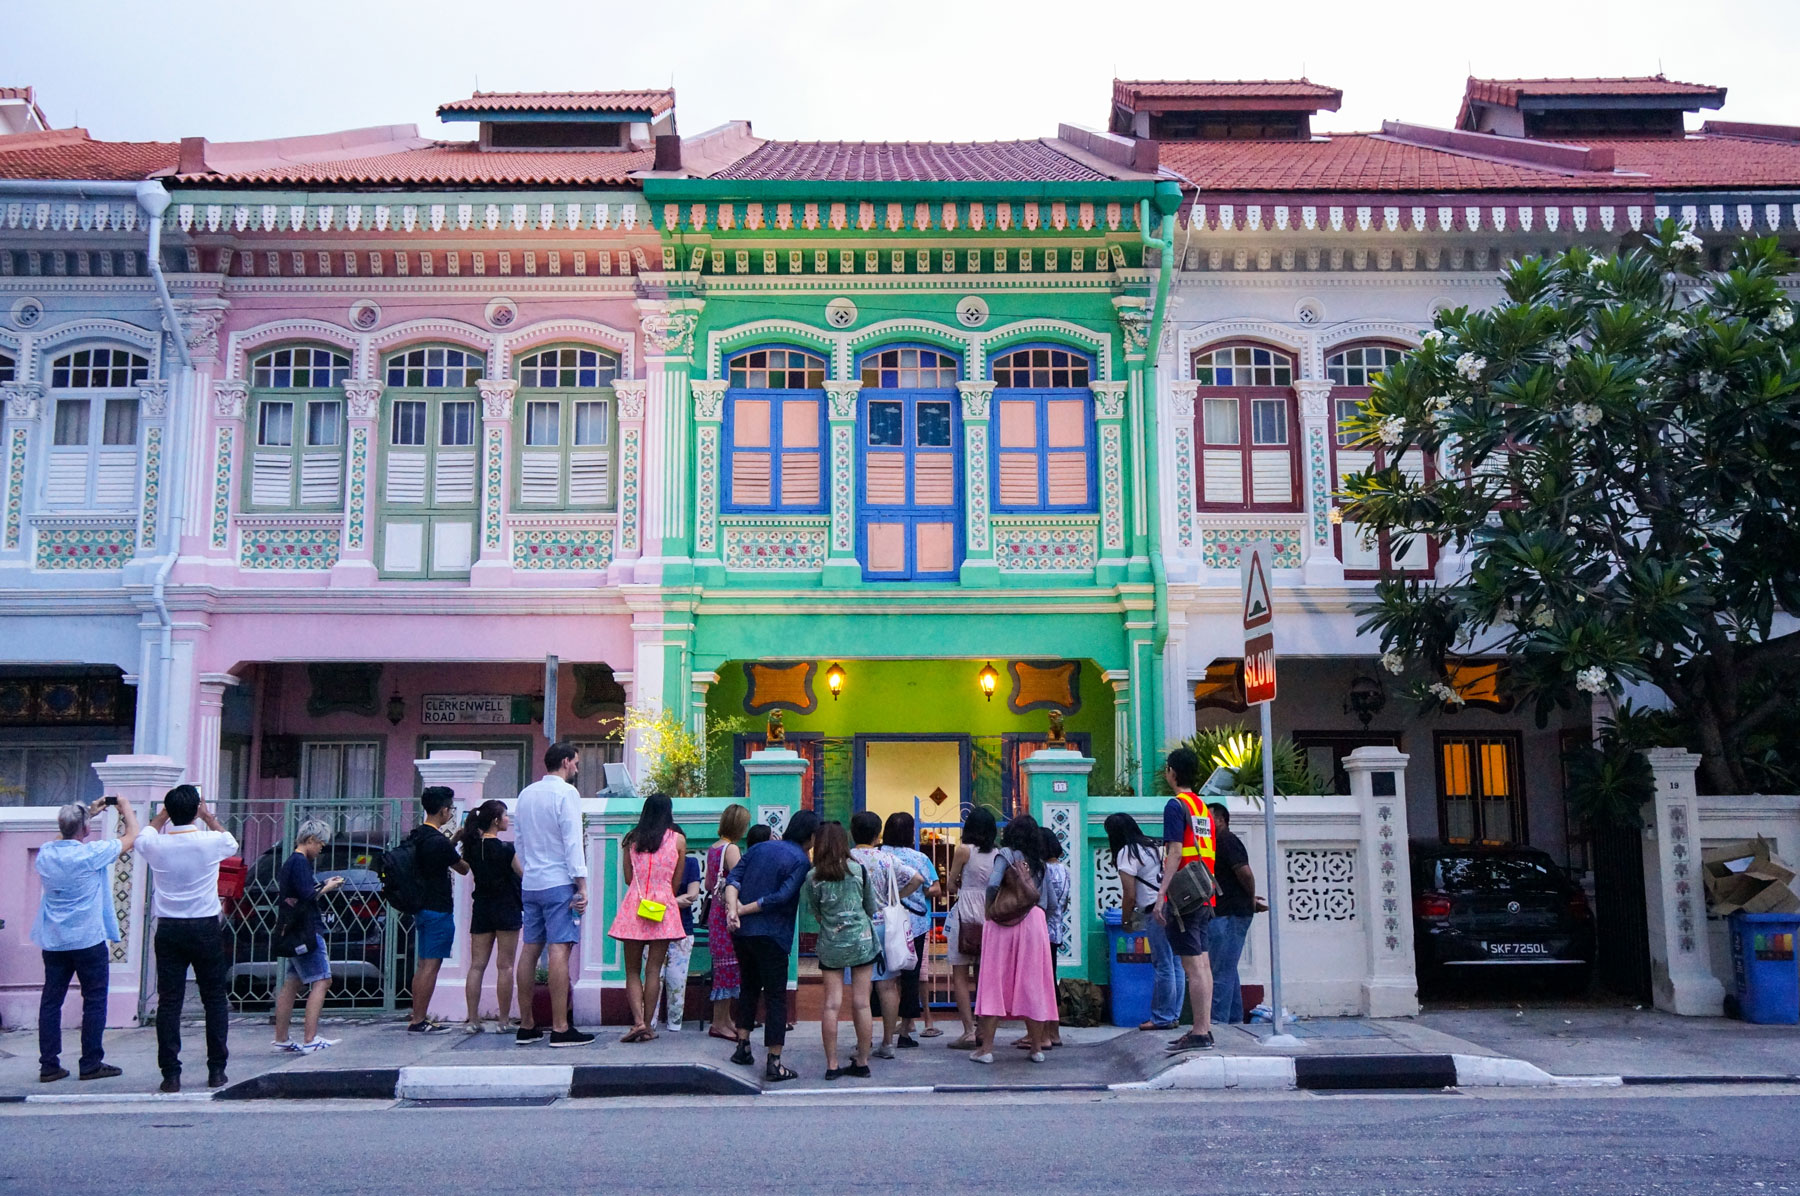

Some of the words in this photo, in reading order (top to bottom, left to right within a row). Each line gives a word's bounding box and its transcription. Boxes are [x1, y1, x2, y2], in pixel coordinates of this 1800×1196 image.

[1245, 649, 1274, 688] SLOW
[425, 701, 503, 711] CLERKENWELL
[425, 712, 456, 721] ROAD
